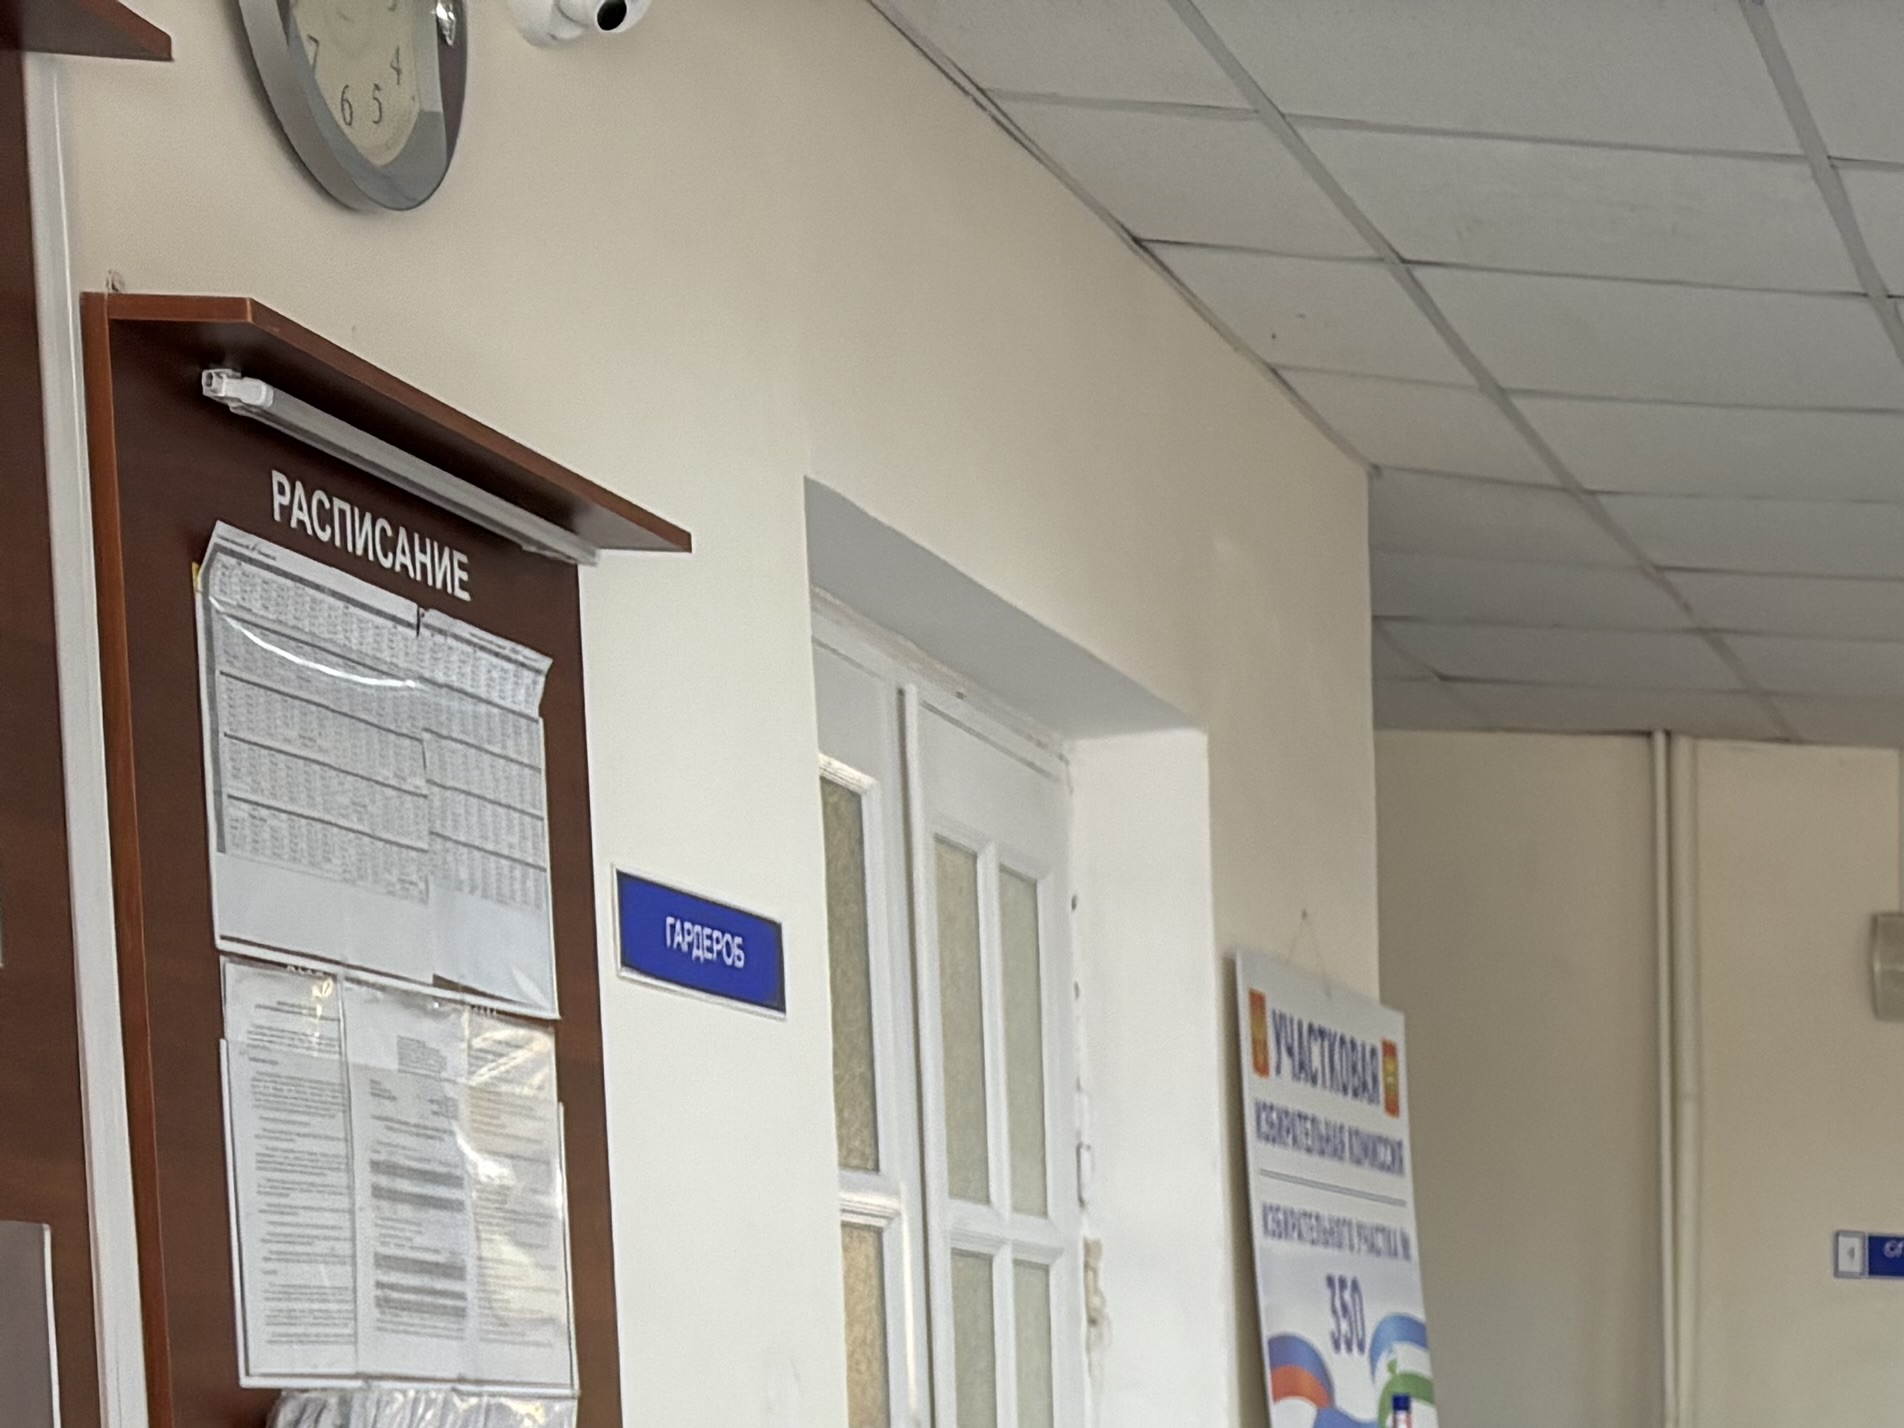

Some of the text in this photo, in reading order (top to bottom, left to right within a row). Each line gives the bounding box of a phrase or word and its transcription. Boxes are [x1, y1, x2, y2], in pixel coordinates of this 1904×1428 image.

[340, 83, 354, 127] 6
[371, 82, 383, 125] 5
[271, 469, 472, 602] РАСПИСАНИЕ
[665, 915, 745, 969] ГАРДЕРОБ
[1271, 1008, 1380, 1106] УЧАСТКОВАЯ
[1325, 1272, 1367, 1356] 350
